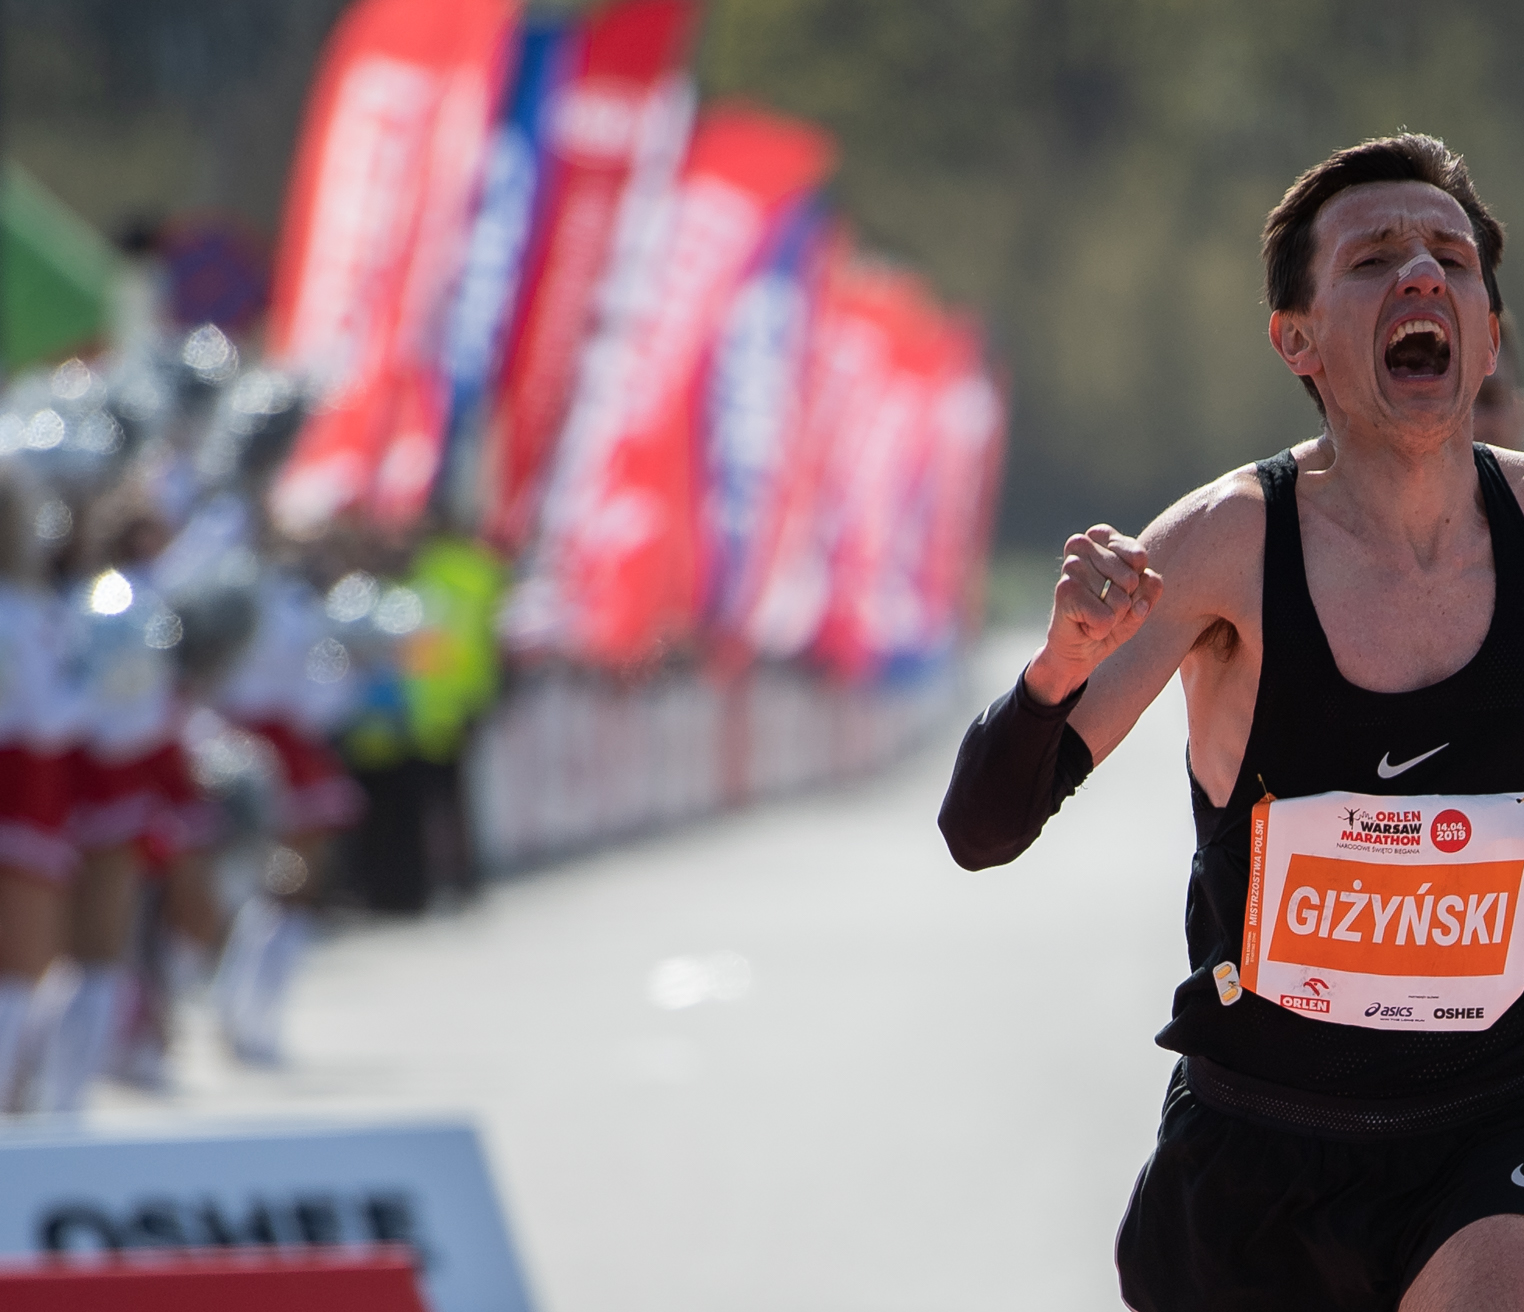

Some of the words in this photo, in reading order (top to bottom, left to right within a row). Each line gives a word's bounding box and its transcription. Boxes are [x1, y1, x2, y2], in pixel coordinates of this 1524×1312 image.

[1375, 811, 1421, 822] ORLEN
[1360, 821, 1422, 834] WARSAW
[1436, 822, 1466, 831] 14.04.
[1254, 819, 1264, 854] POLSKI
[1340, 830, 1421, 846] MARATHON
[1436, 830, 1466, 842] 2019
[1336, 842, 1371, 852] NARODOWE
[1249, 855, 1262, 926] MISTRZOSTWA
[1286, 879, 1509, 946] GIŻYŃSKI
[1282, 996, 1328, 1011] ORLEN
[1434, 1007, 1485, 1019] OSHEE
